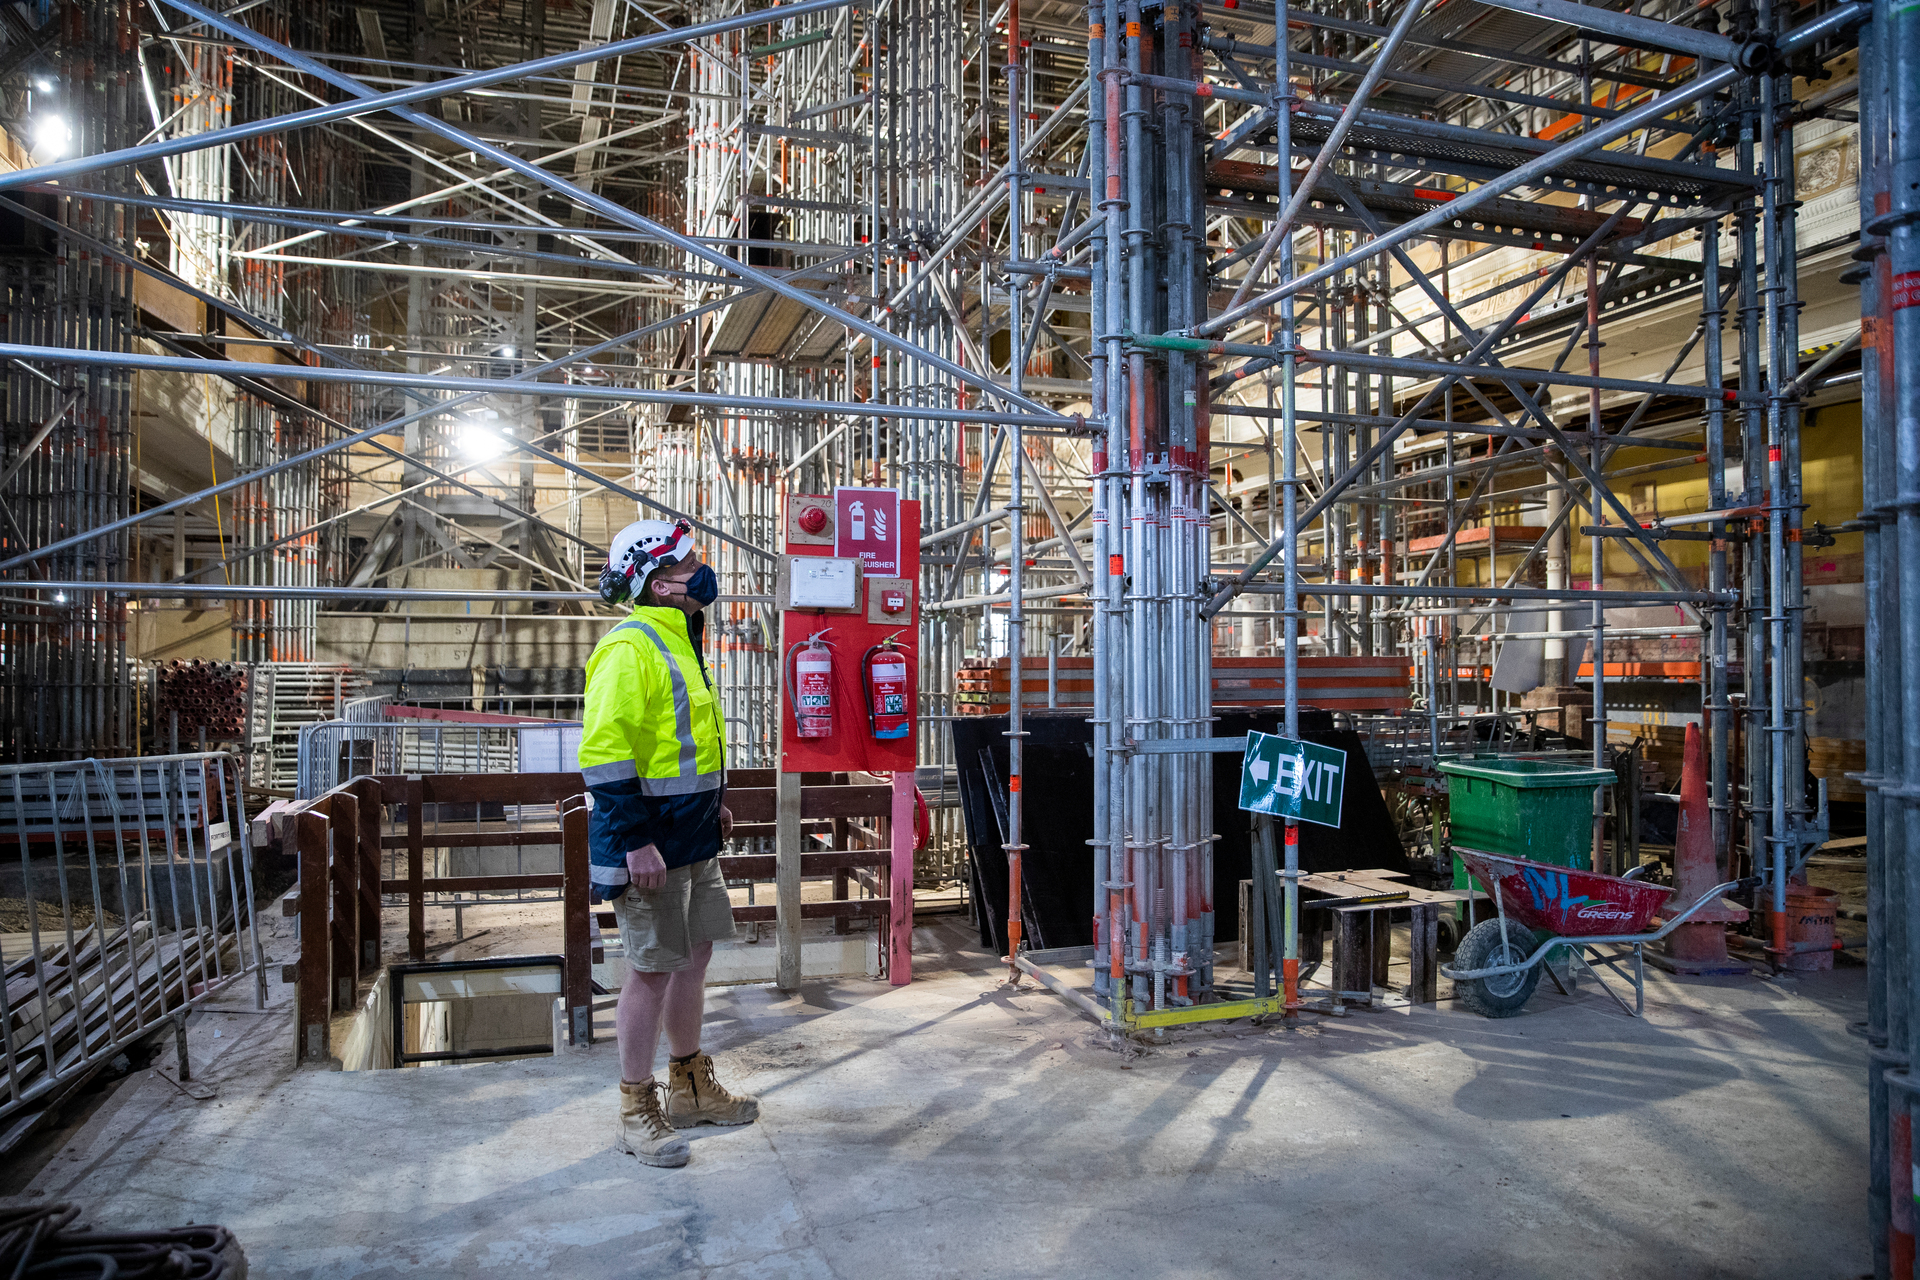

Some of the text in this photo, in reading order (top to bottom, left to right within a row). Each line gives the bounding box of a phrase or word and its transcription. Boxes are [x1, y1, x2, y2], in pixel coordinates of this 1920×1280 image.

[859, 551, 876, 560] FIRE
[863, 561, 895, 569] GUISHER
[1274, 753, 1339, 804] EXIT
[1577, 909, 1636, 920] GREENS
